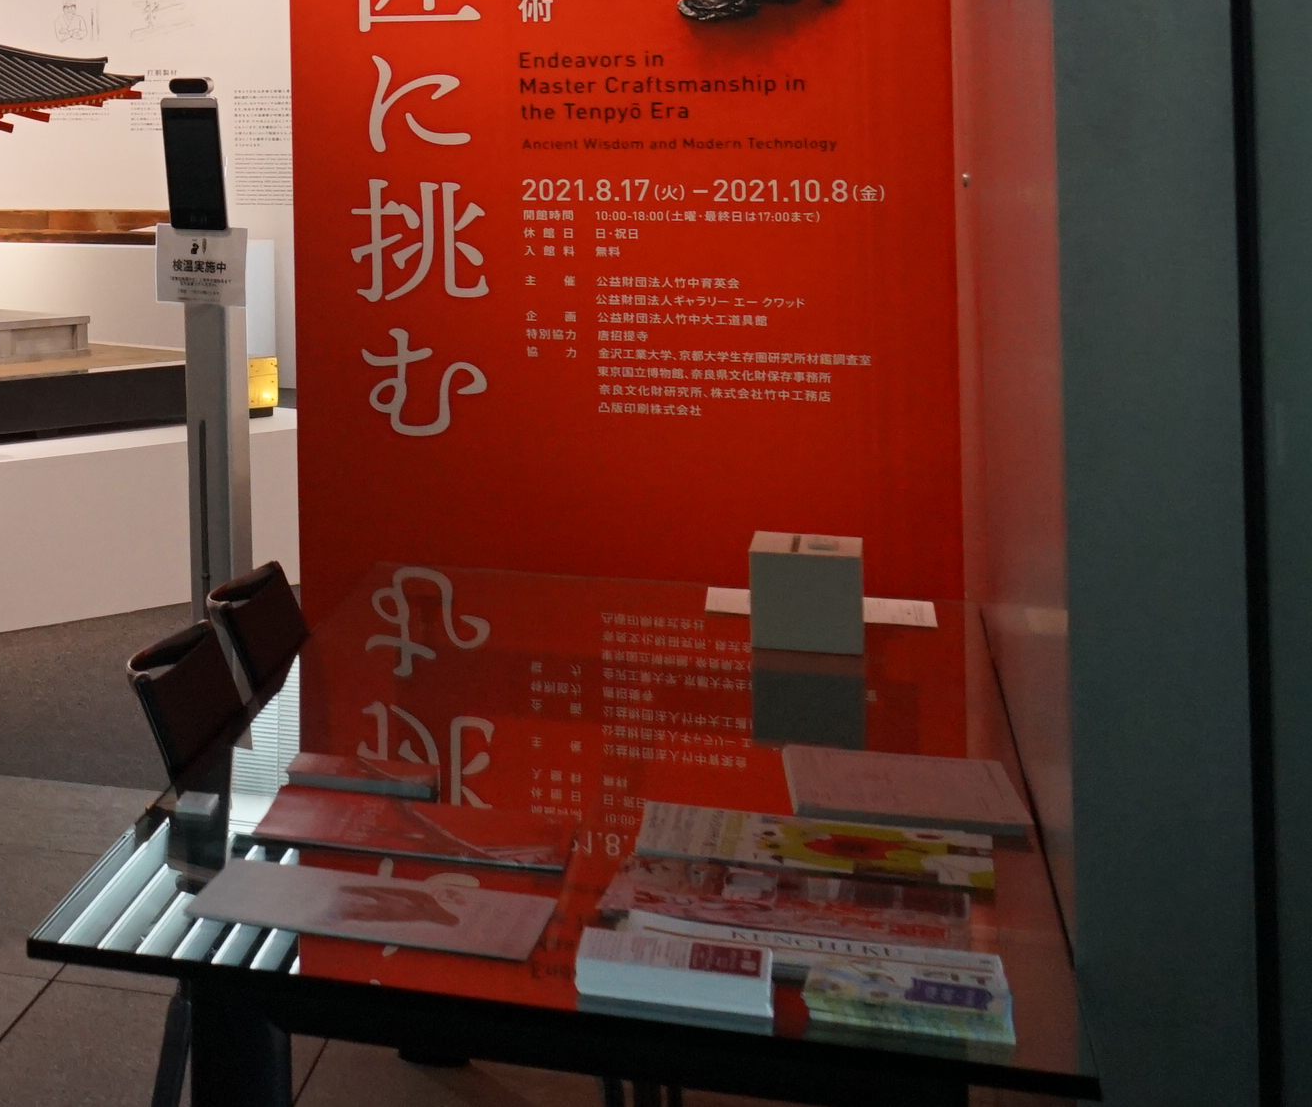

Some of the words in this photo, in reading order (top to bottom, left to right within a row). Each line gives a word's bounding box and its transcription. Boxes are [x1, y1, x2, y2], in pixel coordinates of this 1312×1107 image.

[519, 51, 637, 69] Endeavors
[644, 50, 665, 68] in
[519, 77, 597, 94] Master
[604, 74, 777, 96] Craftsmanship
[785, 74, 806, 92] in
[521, 104, 556, 120] the
[564, 102, 642, 123] Tenpyō
[650, 101, 690, 119] Era
[522, 138, 578, 150] Ancient
[583, 138, 644, 150] Wisdom
[649, 138, 677, 150] and
[682, 137, 742, 150] Modern
[748, 137, 838, 152] Technology
[523, 210, 575, 222] 開館時間
[595, 228, 639, 240] 日・祝日
[595, 246, 621, 258] 無料
[172, 259, 227, 274] 検温実施中
[596, 276, 740, 289] 公益財団法人竹中育英会
[597, 312, 768, 327] 公益財団法人竹中大工道具館
[526, 328, 577, 341] 特別協力
[597, 330, 649, 342] 唐招提寺
[598, 402, 702, 417] 凸版印刷株式会社
